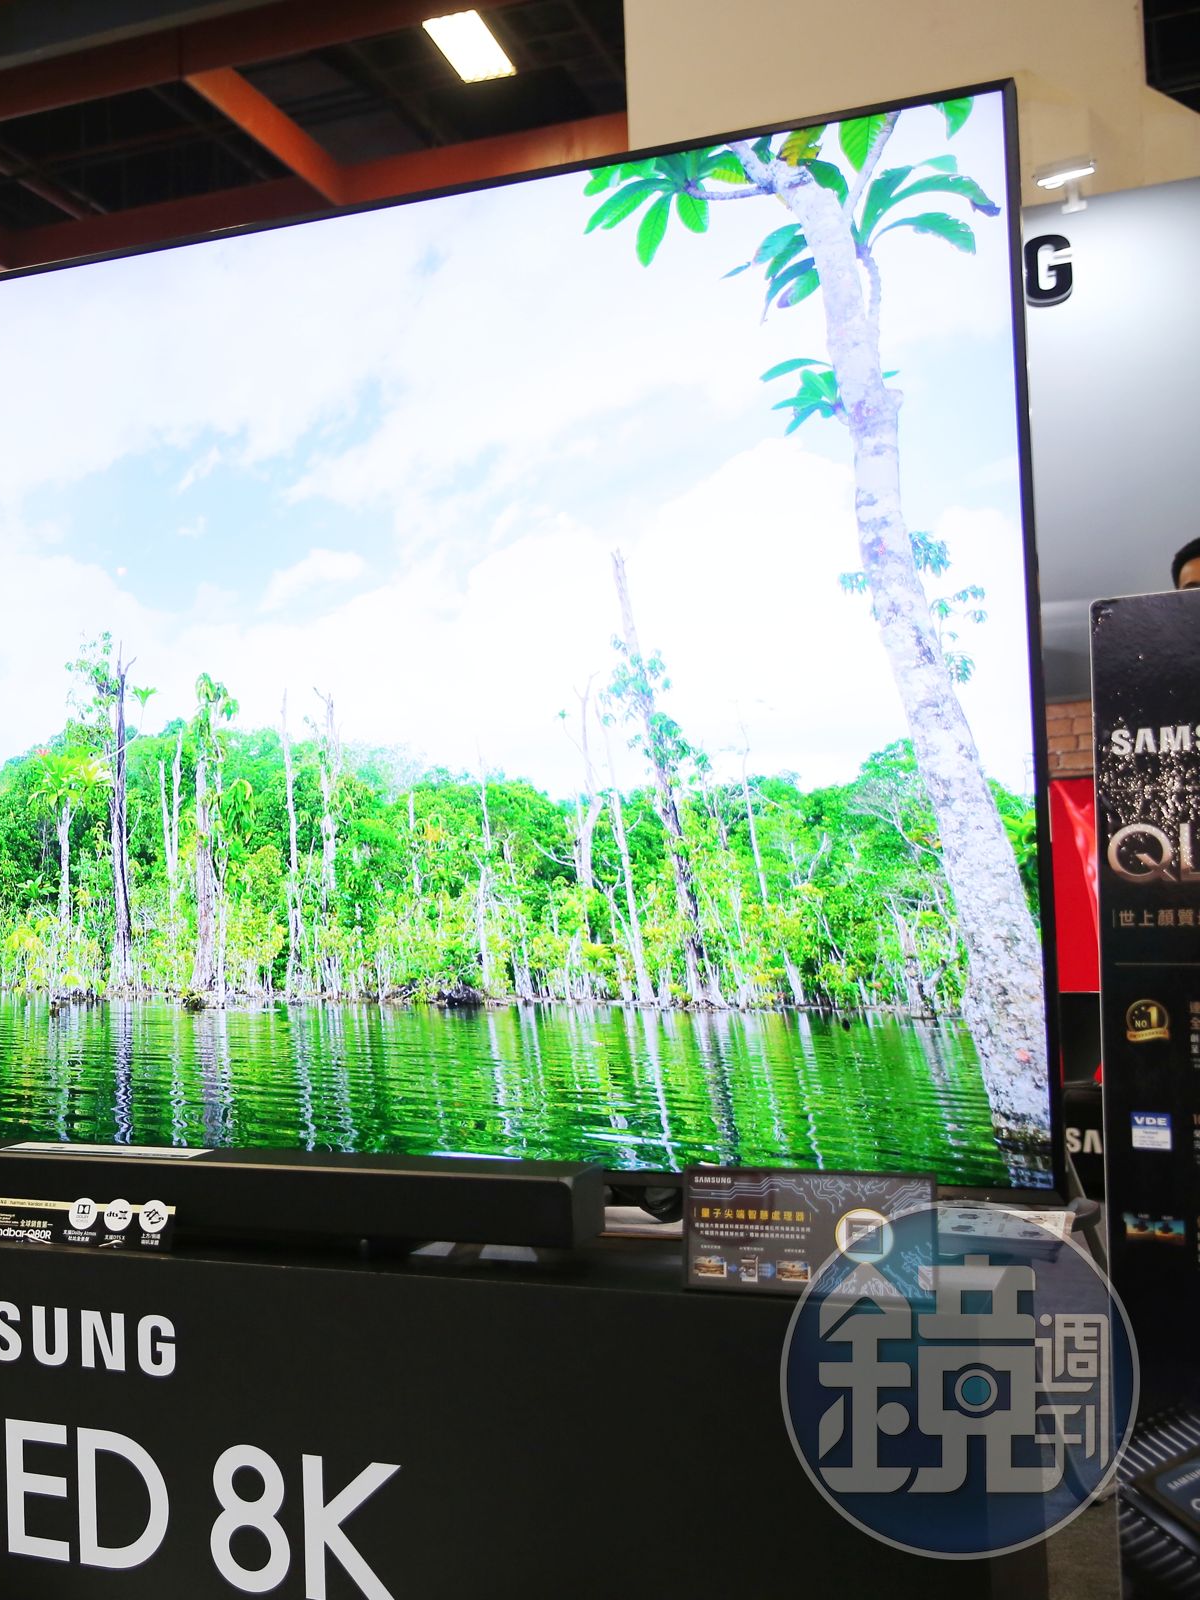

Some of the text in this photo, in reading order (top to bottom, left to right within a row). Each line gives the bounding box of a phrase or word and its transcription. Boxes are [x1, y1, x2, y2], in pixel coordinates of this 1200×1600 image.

[1024, 234, 1073, 308] G
[1119, 909, 1200, 927] 世上顏質
[1134, 1116, 1168, 1126] VDE
[1065, 1127, 1103, 1154] SA
[694, 1176, 732, 1184] SAMSUNG
[210, 1444, 403, 1600] 8K
